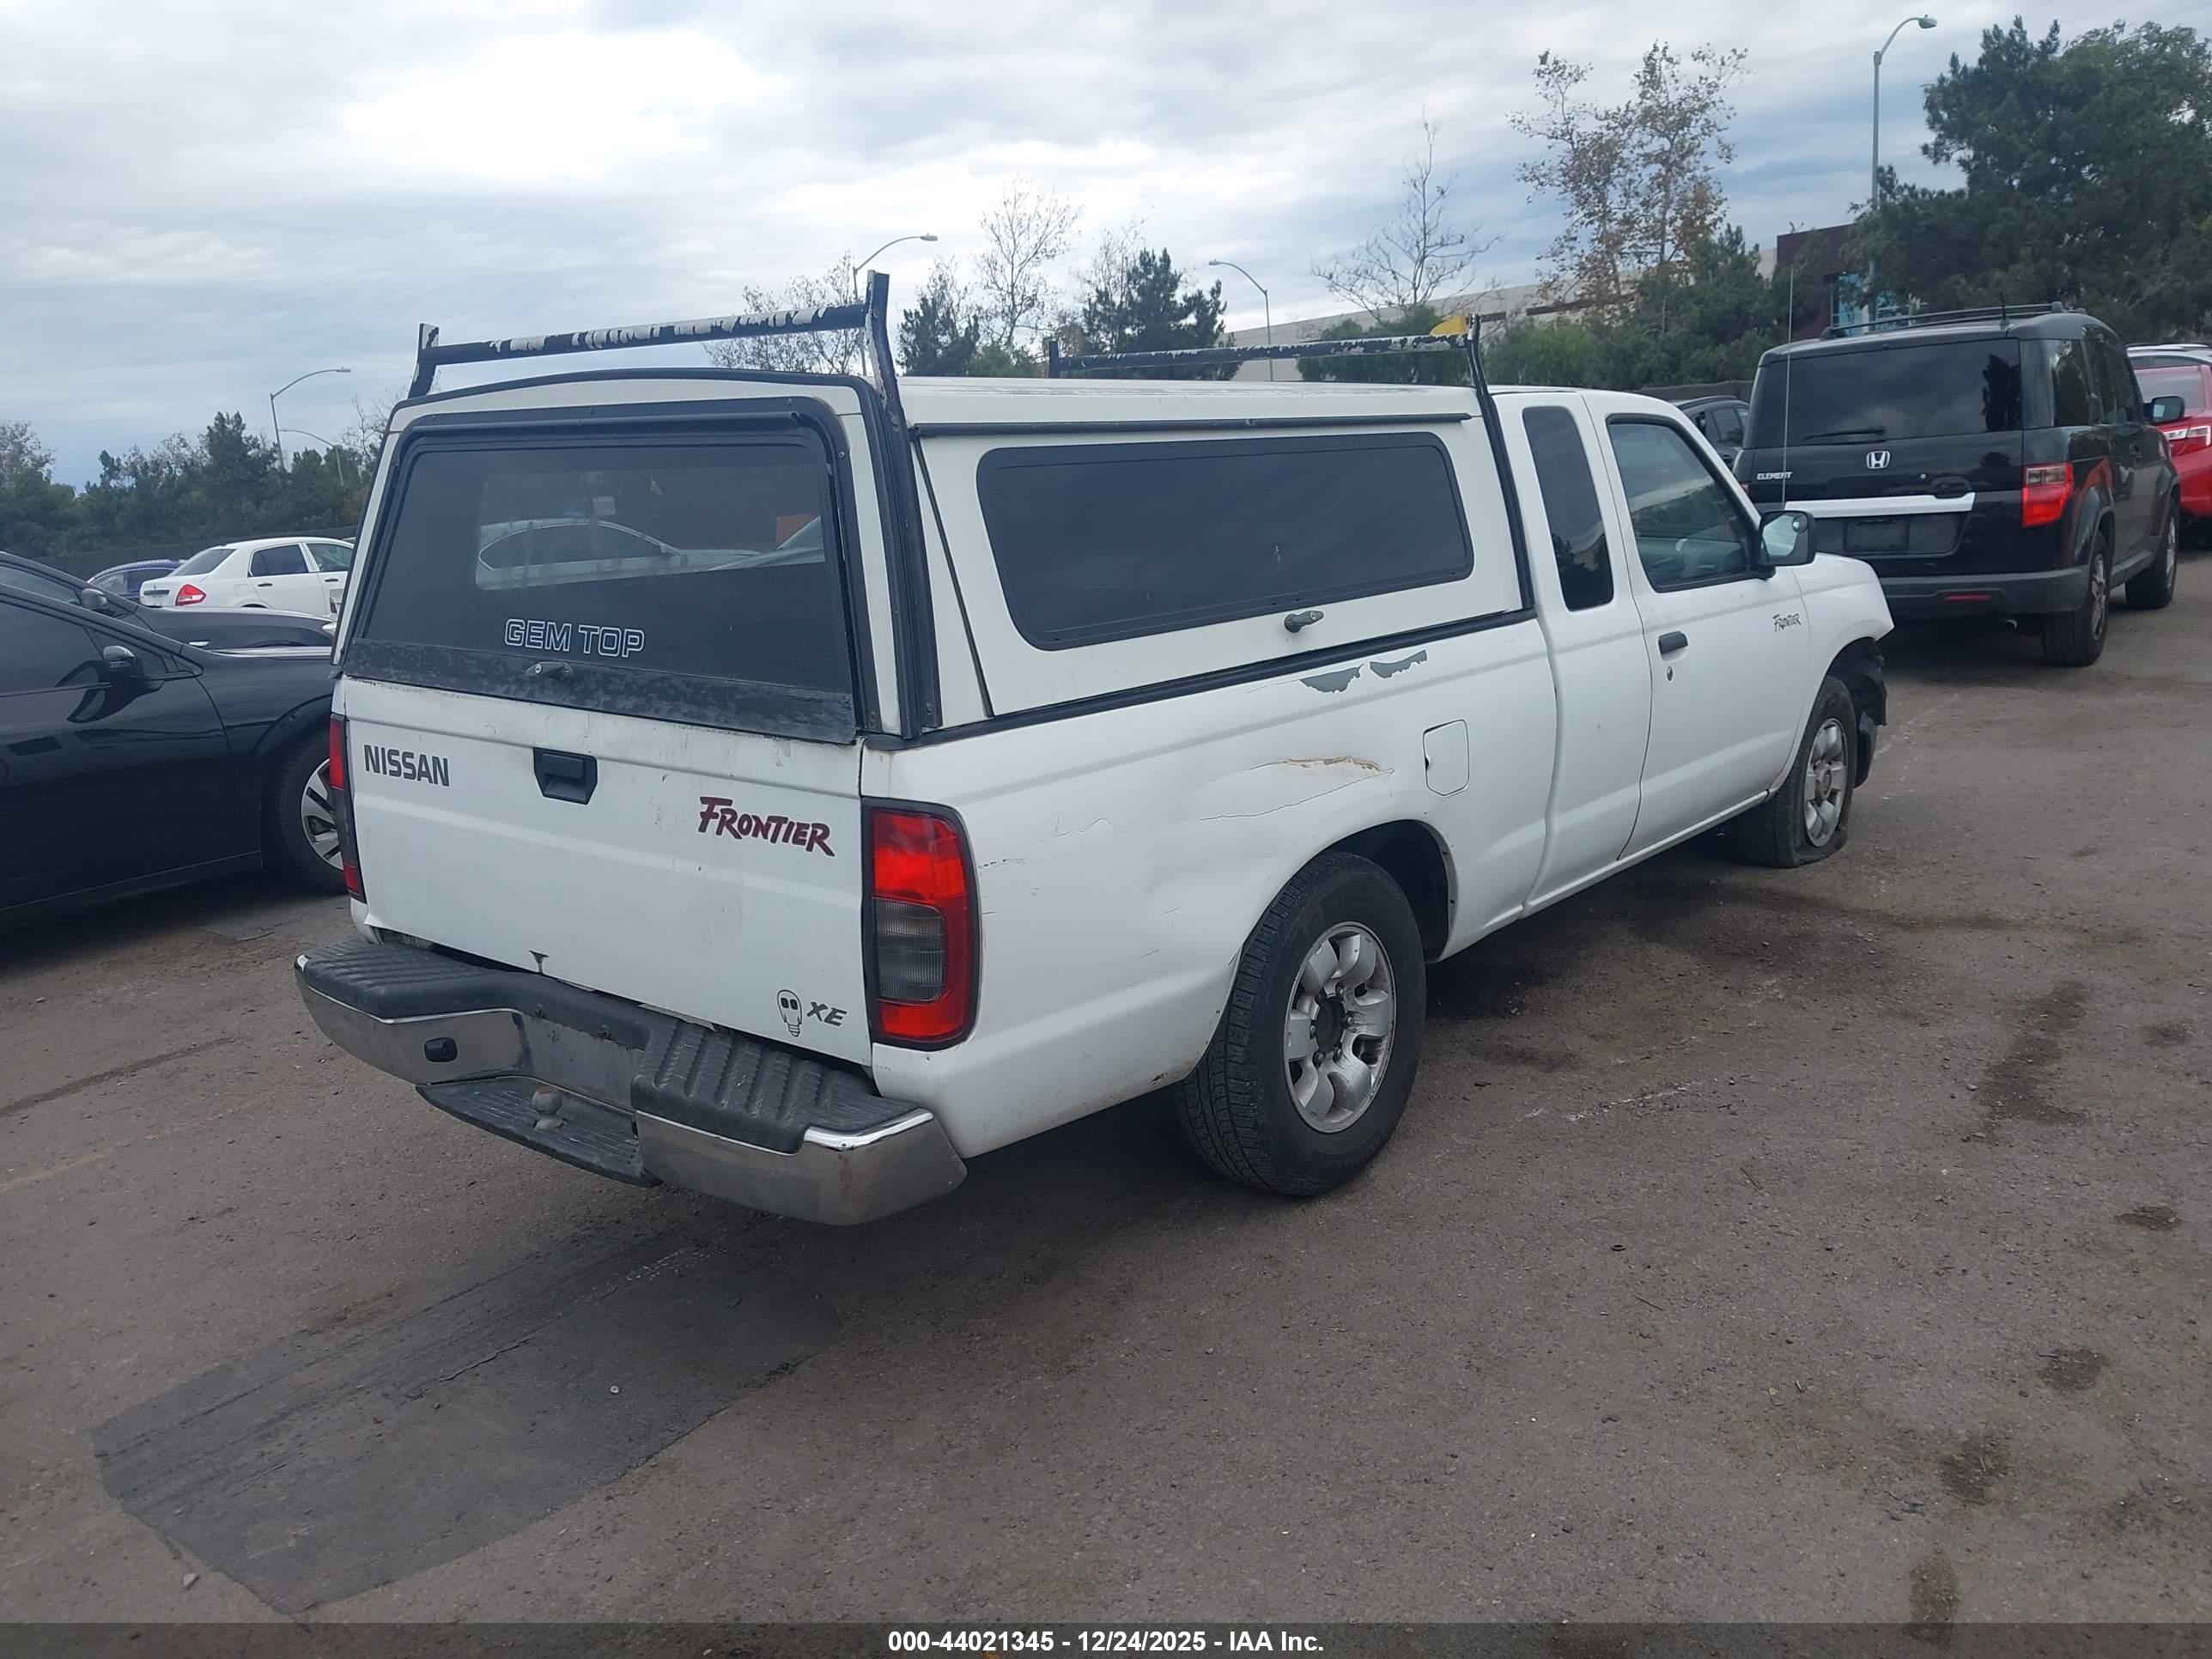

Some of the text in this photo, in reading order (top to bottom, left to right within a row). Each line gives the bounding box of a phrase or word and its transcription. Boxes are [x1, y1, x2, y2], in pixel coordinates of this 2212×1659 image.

[1756, 471, 1794, 481] ELEMENT
[504, 618, 645, 659] GEM TOP
[363, 744, 450, 787] NISSAN
[697, 795, 836, 858] FRONTIER
[806, 1000, 848, 1027] XE
